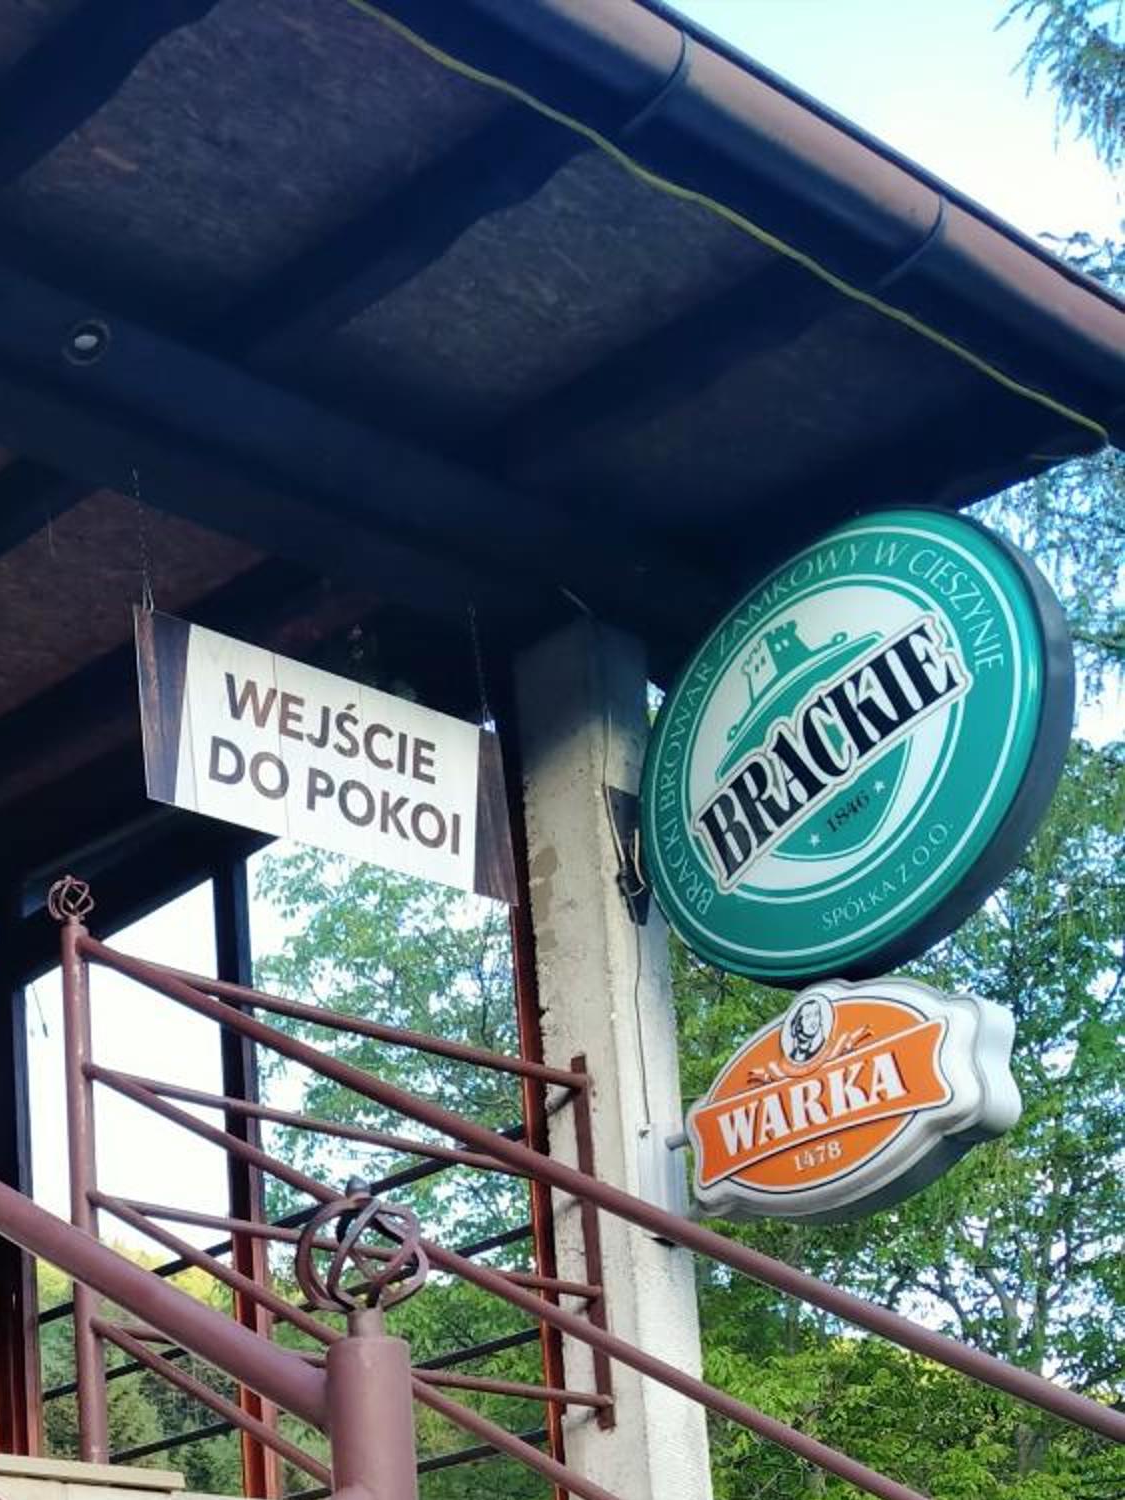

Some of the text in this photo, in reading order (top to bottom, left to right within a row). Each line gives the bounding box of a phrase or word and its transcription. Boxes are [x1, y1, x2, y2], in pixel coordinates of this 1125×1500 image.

[225, 672, 437, 785] WEJŚCIE
[659, 540, 1004, 915] BRACKI BROWAR ZAMKOWY W CIESZYNIE
[698, 624, 960, 881] BRACKIE
[208, 735, 461, 856] DO POKOI
[826, 790, 870, 832] 1846
[716, 1051, 910, 1158] WARKA
[793, 1141, 843, 1172] 1478
